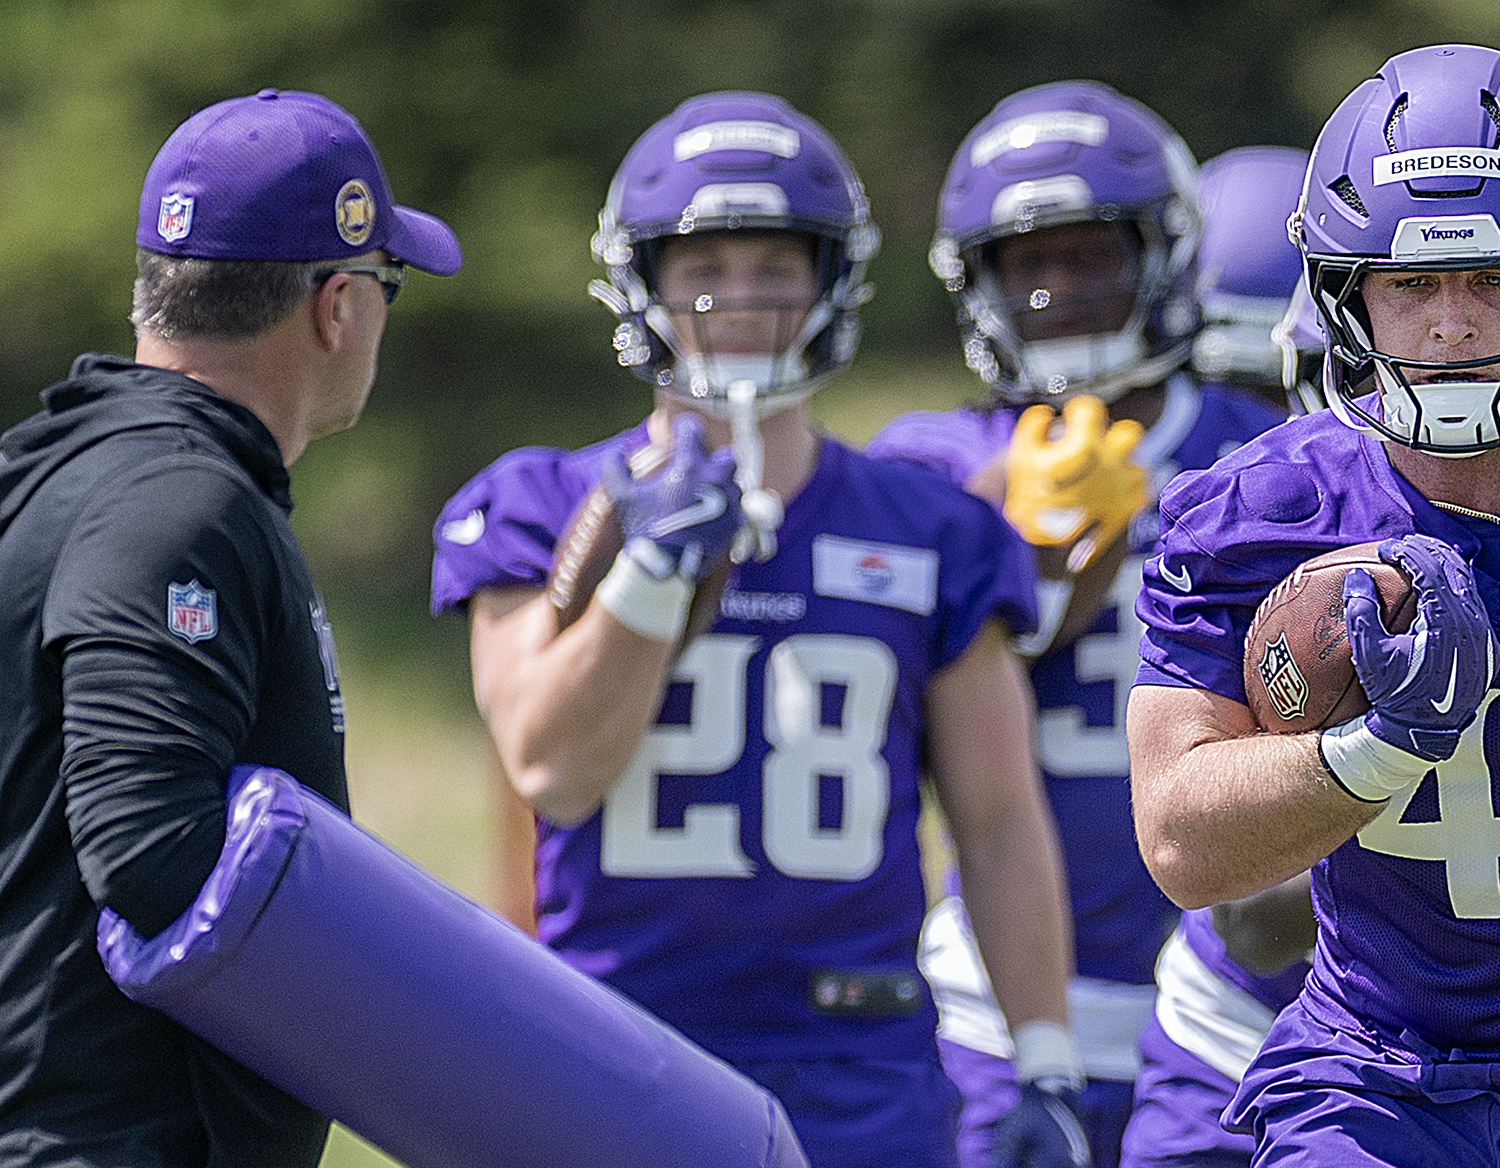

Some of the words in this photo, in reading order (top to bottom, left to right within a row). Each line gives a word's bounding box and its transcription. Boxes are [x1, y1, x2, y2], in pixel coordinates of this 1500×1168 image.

[1391, 155, 1500, 174] BREDESON
[174, 606, 211, 634] NFL
[1269, 667, 1303, 713] NFL
[601, 634, 897, 880] 28
